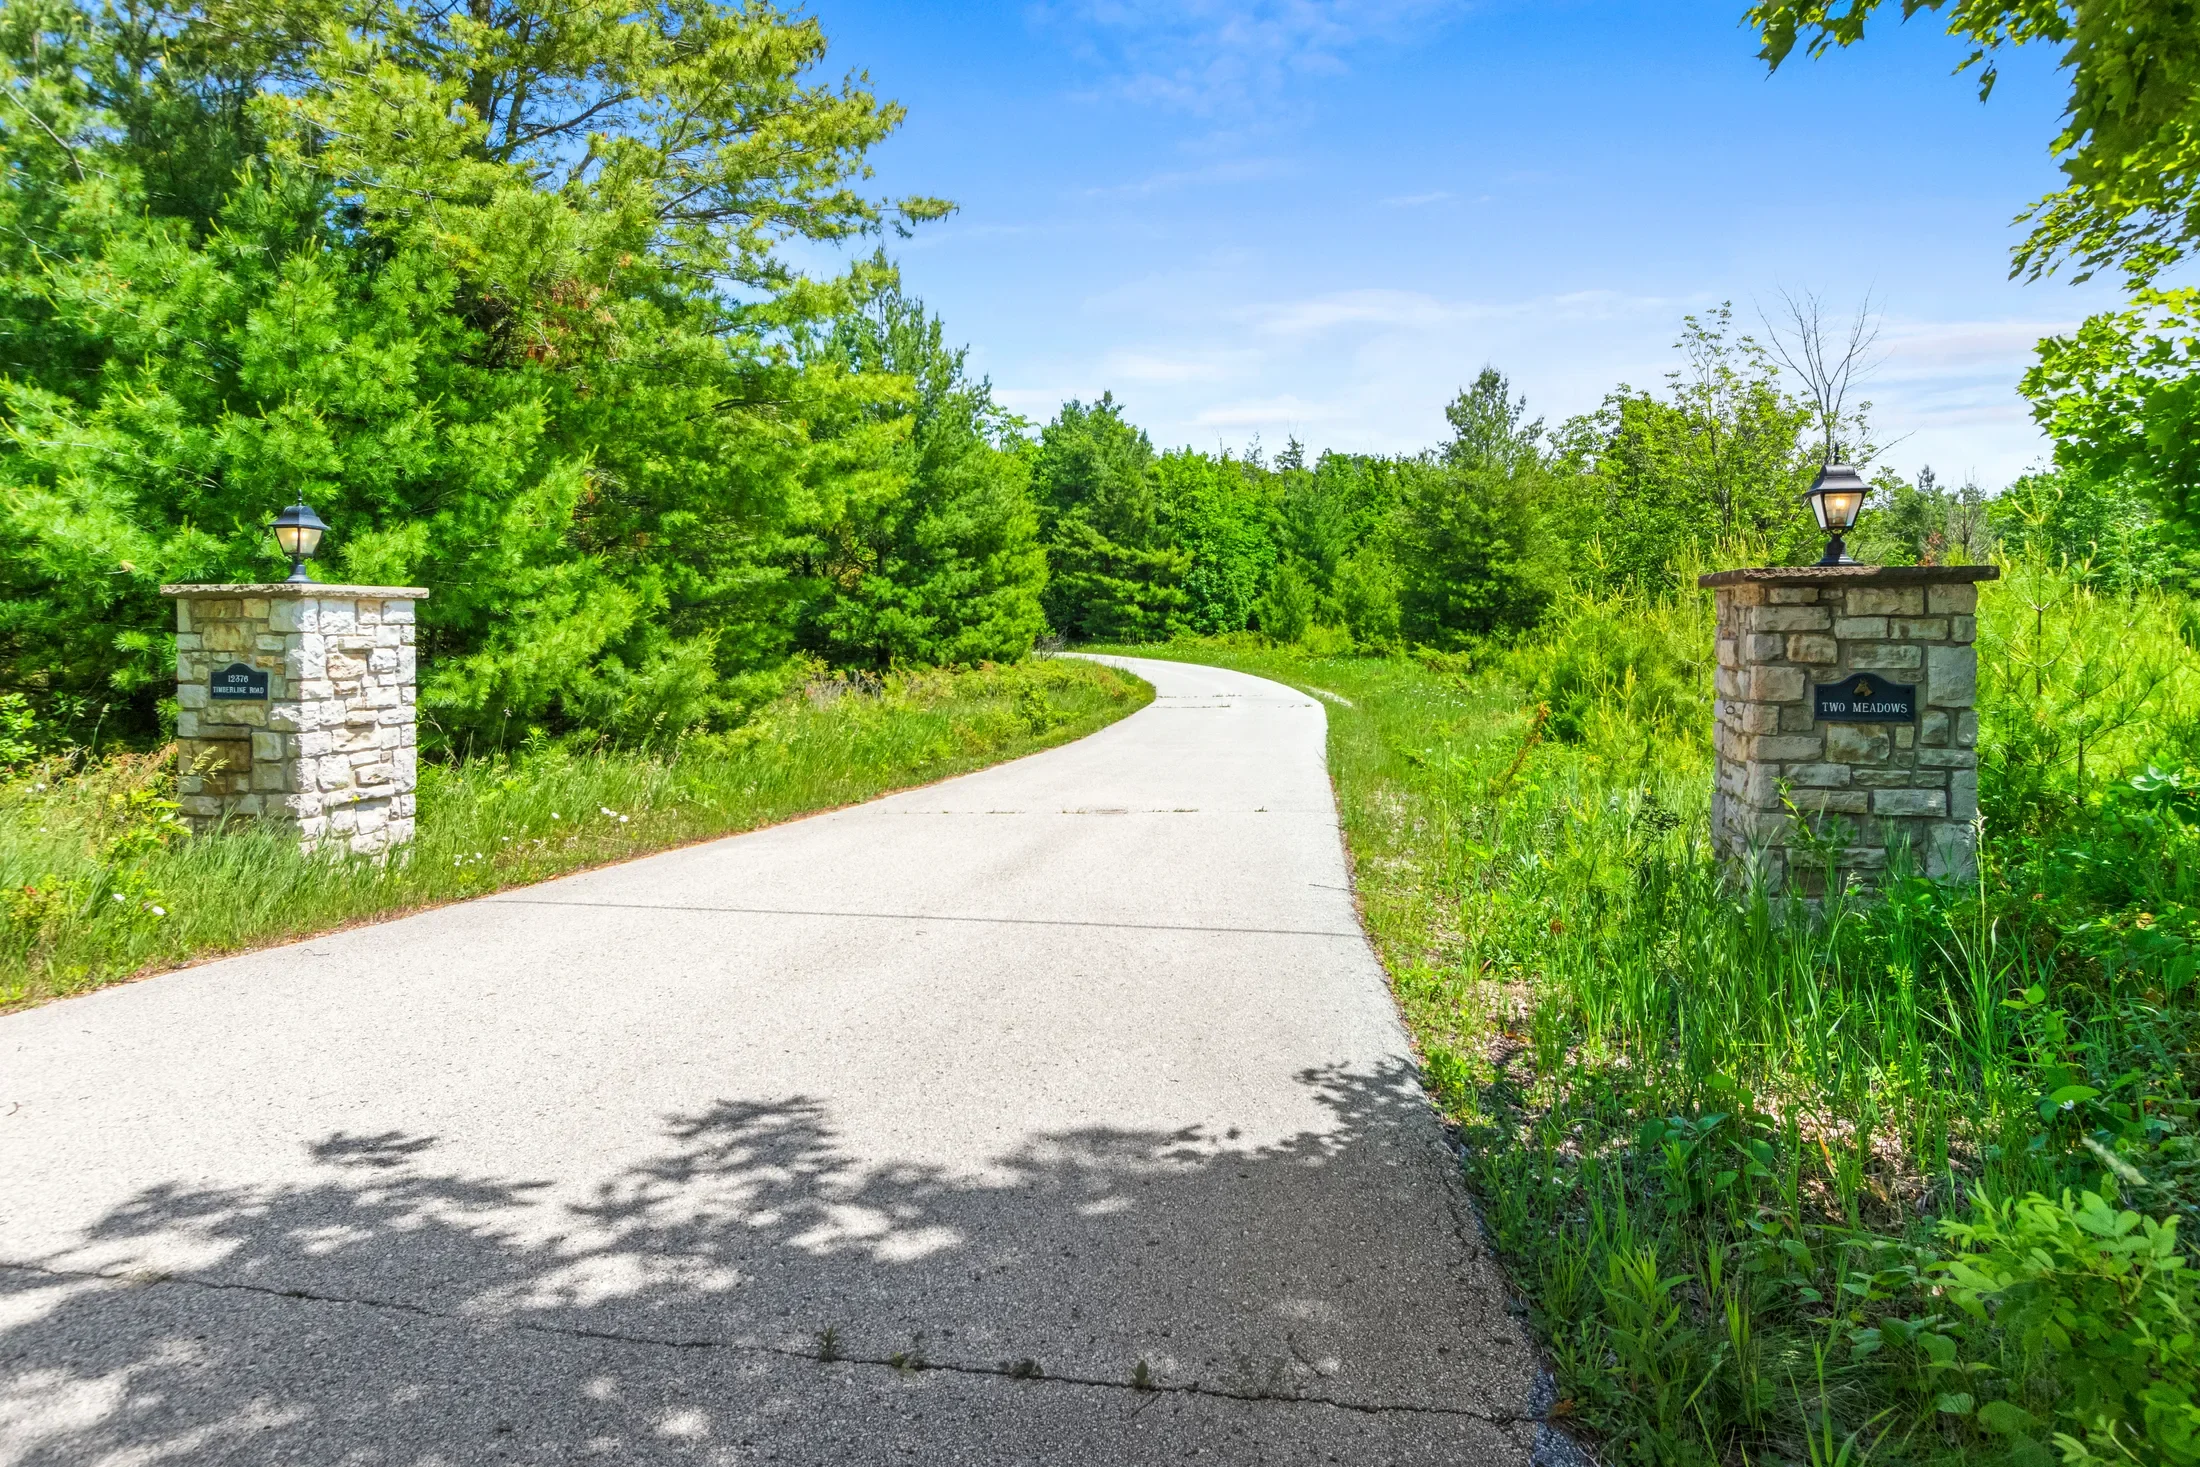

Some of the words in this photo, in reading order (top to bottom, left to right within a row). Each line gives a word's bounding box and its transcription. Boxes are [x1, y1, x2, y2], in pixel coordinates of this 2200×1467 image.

[212, 686, 247, 694] TIMBERLINE
[249, 686, 265, 694] ROAD
[1821, 701, 1846, 712] TWO
[1852, 702, 1908, 713] MEADOWS
